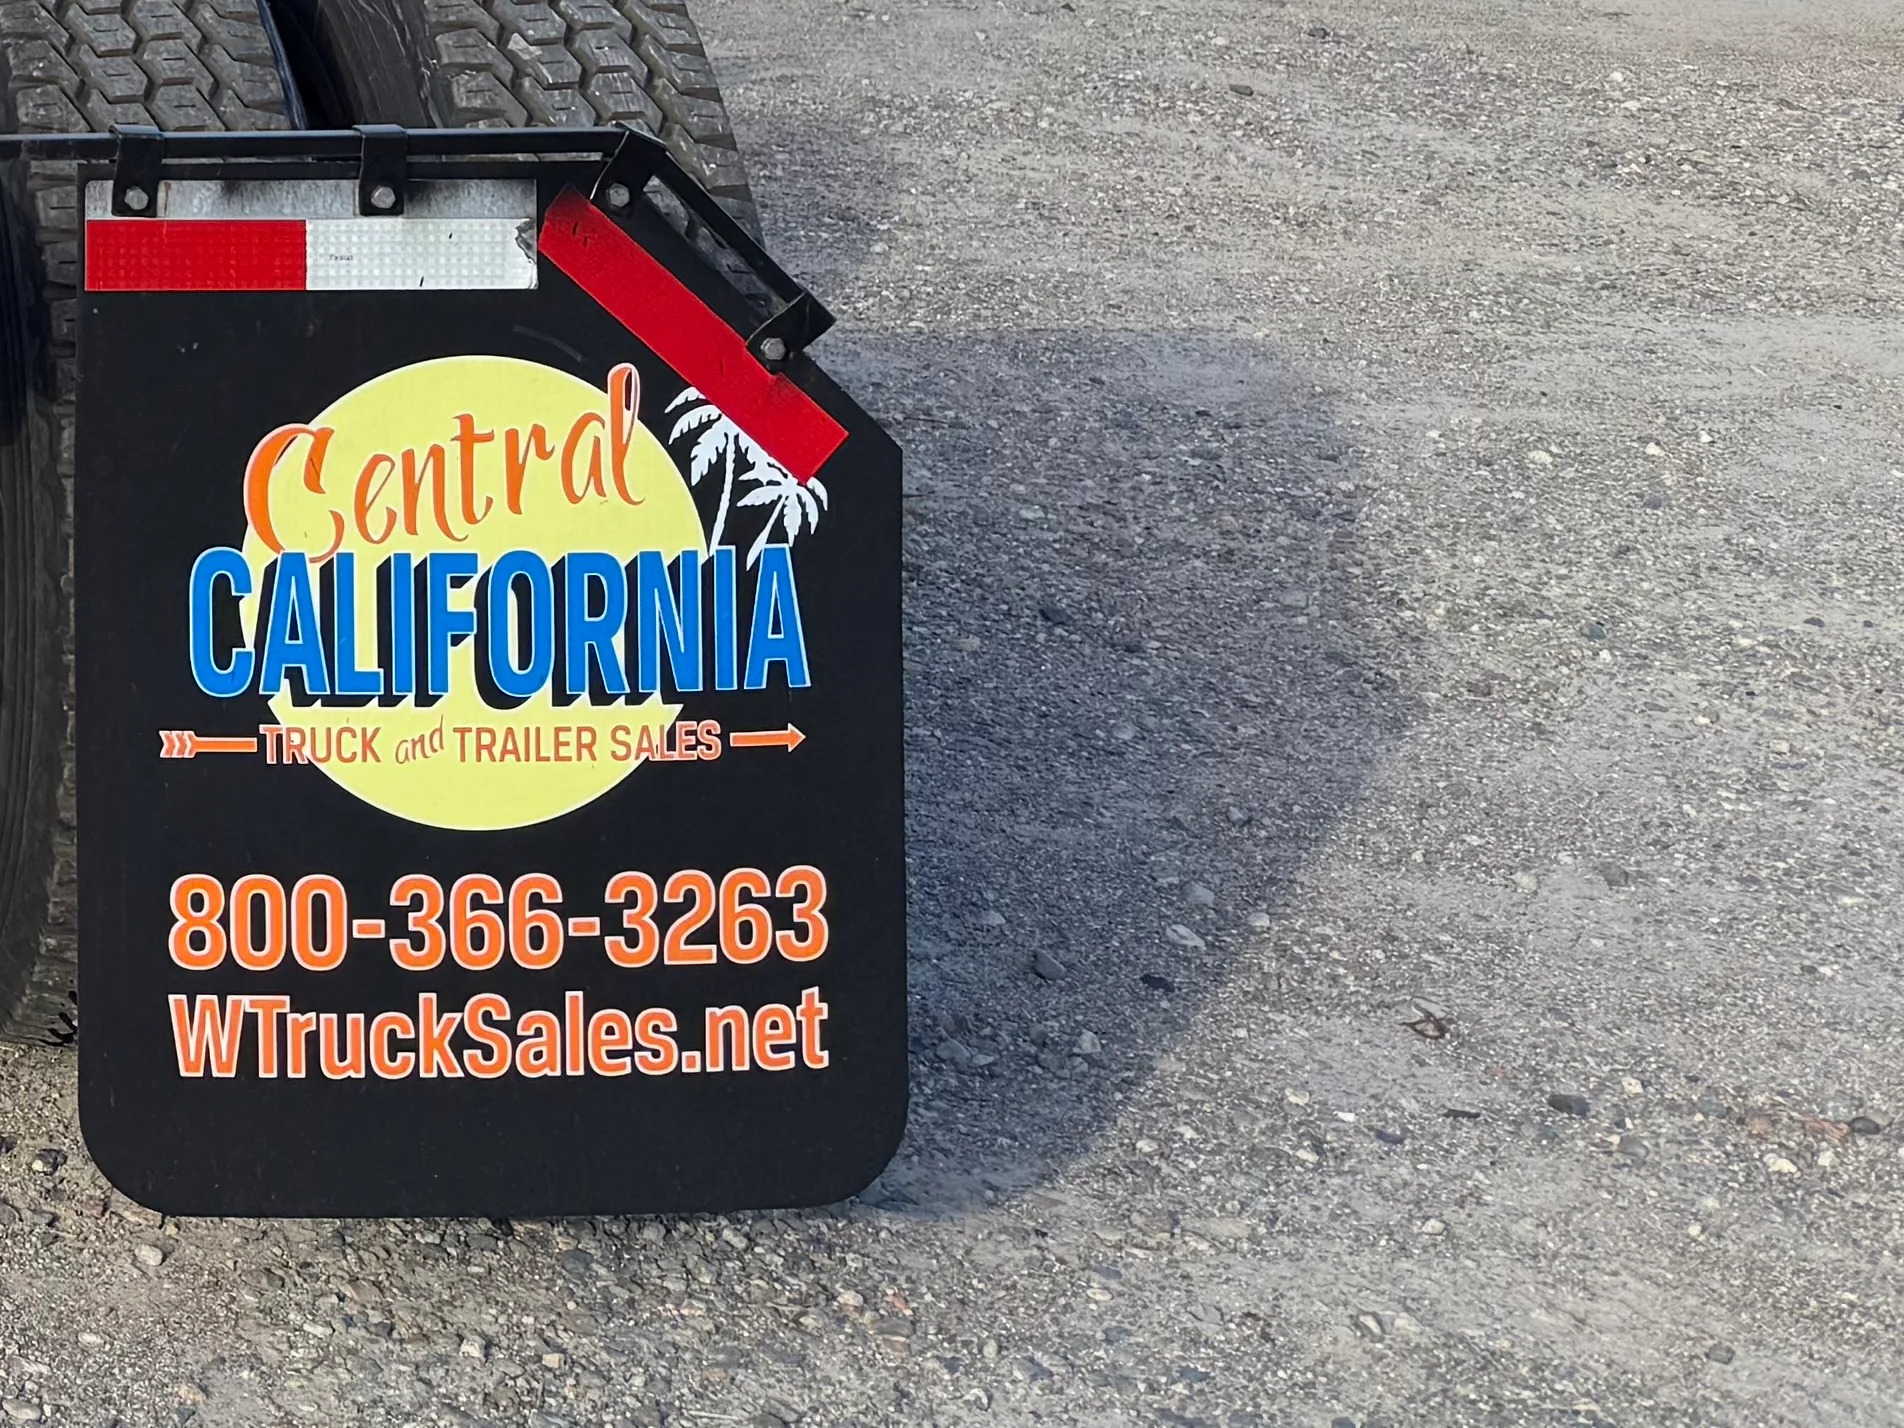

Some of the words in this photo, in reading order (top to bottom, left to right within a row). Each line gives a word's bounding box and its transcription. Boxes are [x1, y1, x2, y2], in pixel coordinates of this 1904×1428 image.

[242, 362, 644, 566] Central
[189, 544, 812, 703] CALIFORNIA
[258, 723, 383, 766] TRUCK
[394, 715, 446, 766] and
[453, 725, 598, 763] TRAILER
[609, 720, 723, 762] SALES
[168, 865, 829, 974] 800-366-3263
[170, 987, 830, 1080] WTruckSales.net
